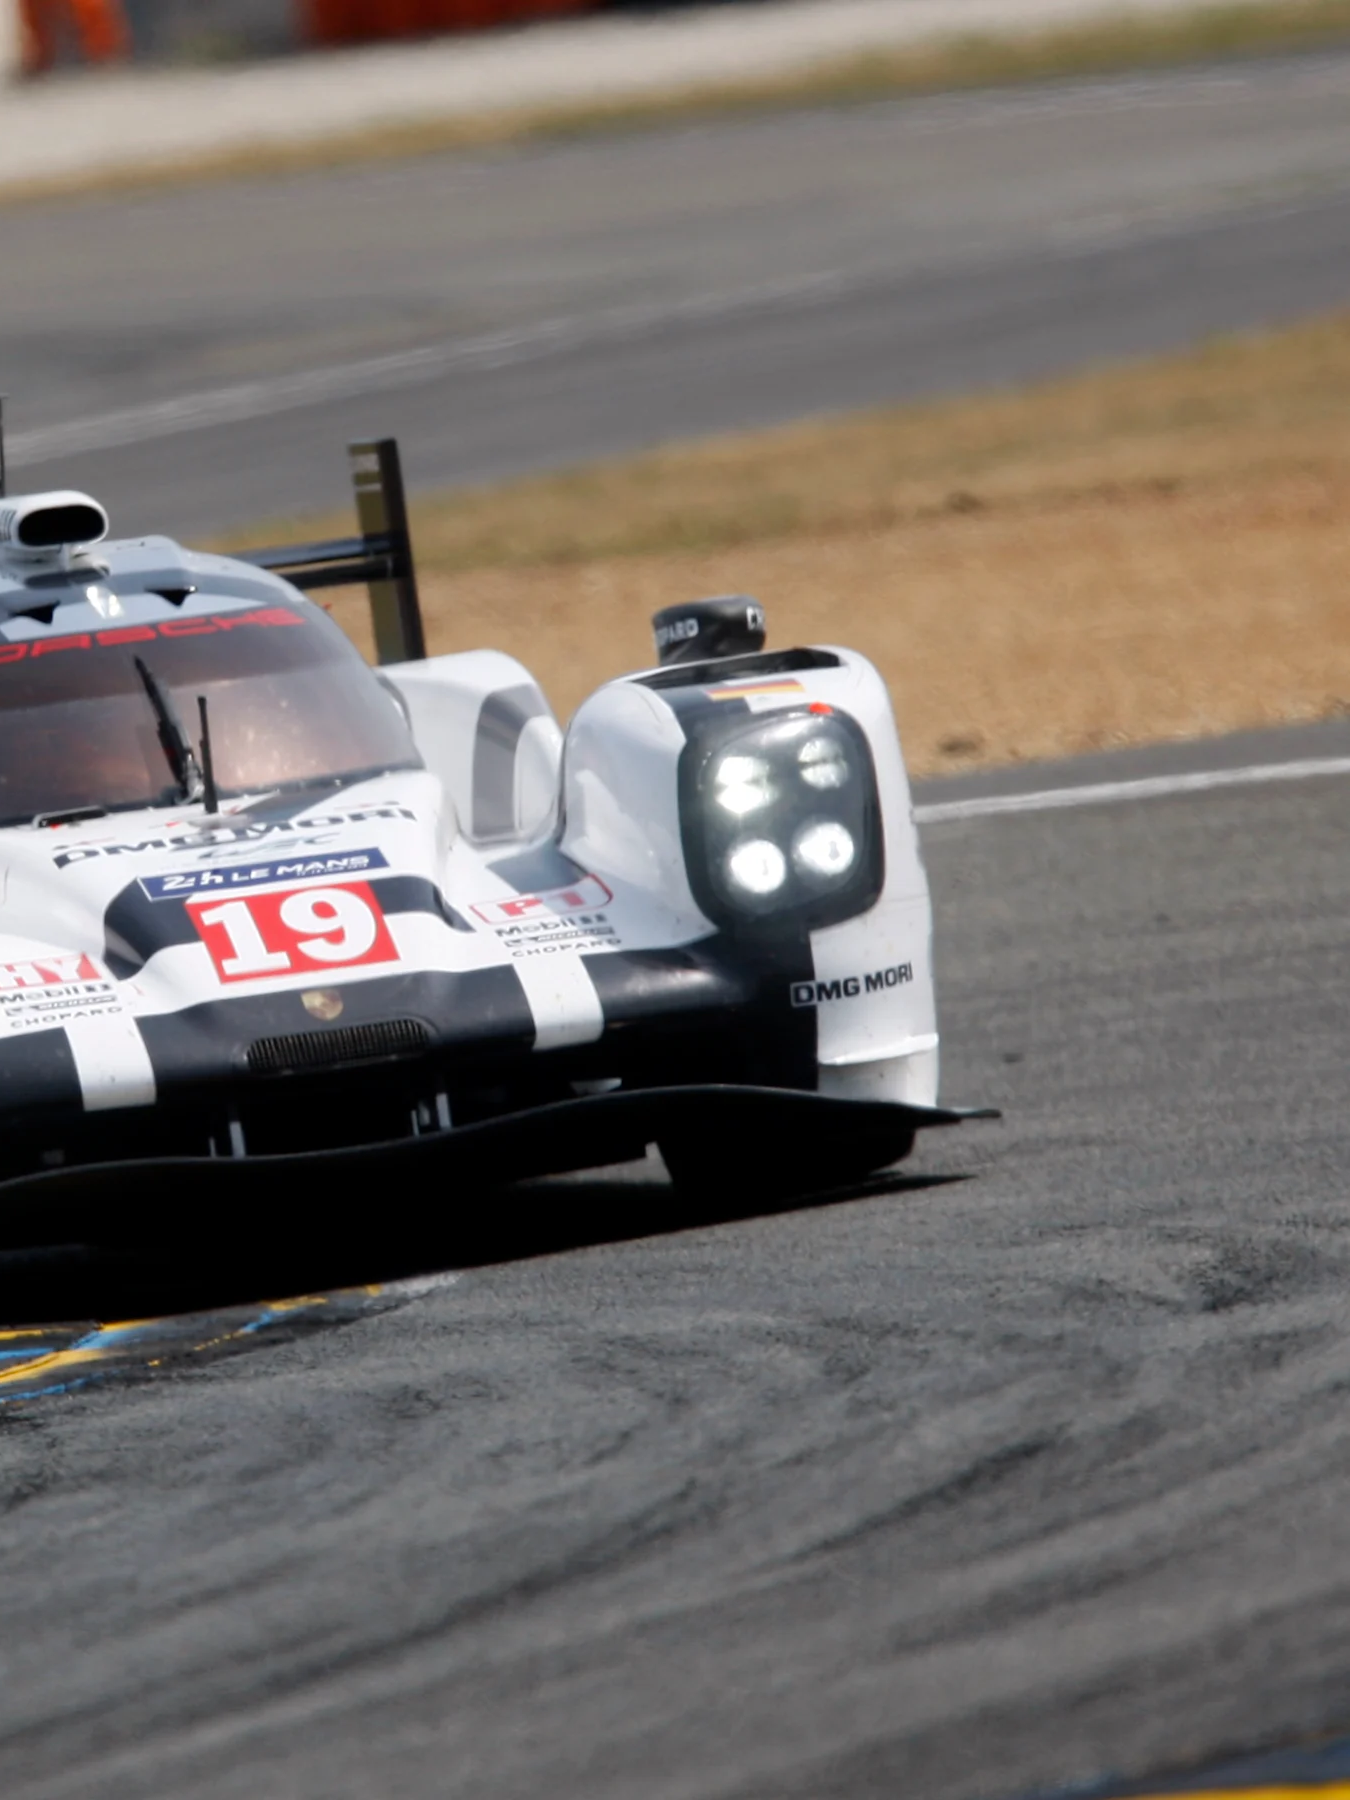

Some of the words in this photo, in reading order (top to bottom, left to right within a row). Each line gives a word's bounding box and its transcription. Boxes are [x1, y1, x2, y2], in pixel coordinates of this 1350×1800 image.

[231, 868, 270, 882] LE
[276, 854, 369, 877] MANS
[497, 890, 586, 918] P1
[200, 888, 377, 977] 19
[495, 916, 576, 937] Mobil
[512, 937, 622, 958] CHOPARD
[792, 977, 860, 1004] DMG
[864, 961, 914, 993] MORI
[11, 1006, 122, 1029] CHOPARD
